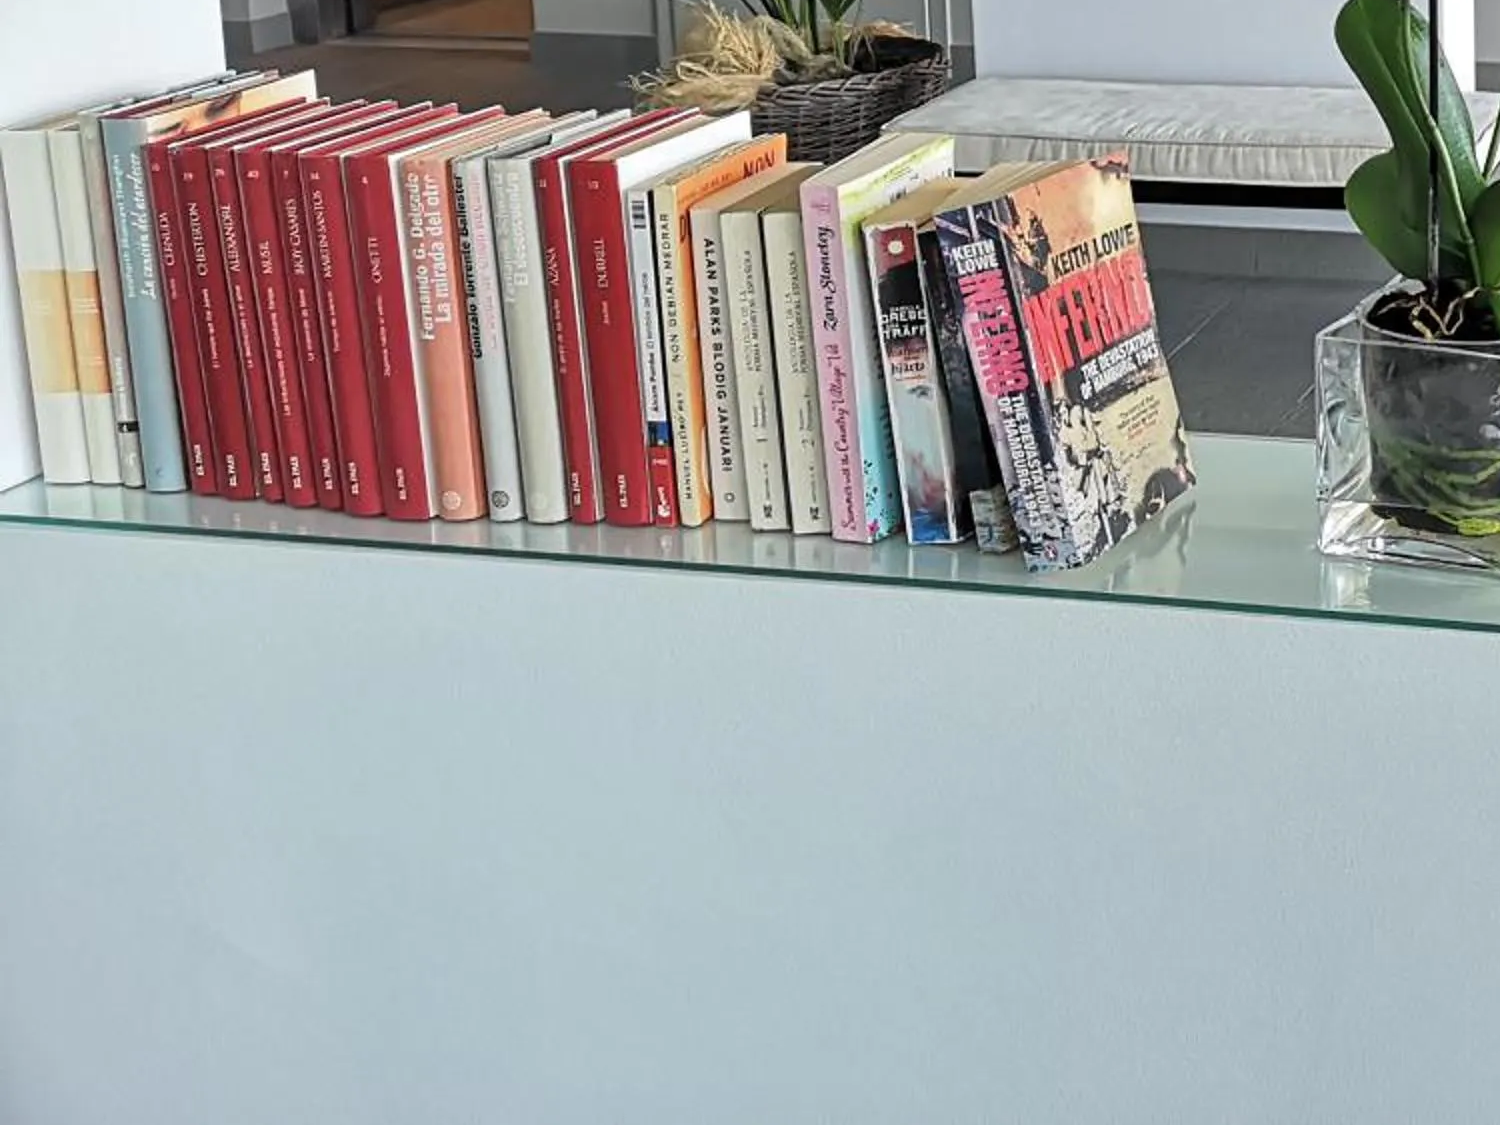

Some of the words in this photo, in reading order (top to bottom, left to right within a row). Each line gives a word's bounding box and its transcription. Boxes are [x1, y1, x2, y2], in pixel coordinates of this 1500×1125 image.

[131, 211, 152, 231] del
[406, 173, 424, 237] Delgado
[425, 211, 443, 235] del
[453, 174, 468, 237] Ballester
[188, 202, 209, 276] CHESTERTON
[411, 243, 426, 259] G.
[659, 213, 673, 269] MEDRAR
[702, 238, 717, 280] ALAN
[951, 239, 996, 261] KEITH
[956, 255, 999, 275] LOWE
[1051, 245, 1091, 275] KEITH
[1094, 223, 1136, 258] LOWE
[428, 241, 450, 297] mirada
[459, 241, 475, 298] Torrente
[415, 266, 434, 340] Fernando
[436, 302, 452, 323] La
[664, 276, 678, 327] DEBIAN
[706, 285, 722, 335] PARKS
[822, 296, 838, 331] Zara
[1023, 251, 1153, 385] INFERNO
[467, 304, 482, 358] Gonzalo
[670, 335, 681, 363] NON
[959, 268, 1030, 398] INFERNO
[1079, 360, 1099, 381] THE
[1097, 329, 1155, 369] DEVASTATION
[710, 342, 727, 399] BLODIG
[829, 364, 847, 407] Village
[1079, 379, 1093, 400] OF
[1135, 346, 1159, 368] 1943
[833, 408, 851, 453] Country
[1010, 392, 1025, 420] THE
[715, 405, 733, 472] JANUARI
[998, 398, 1011, 415] OF
[1022, 490, 1041, 526] 1943
[1017, 421, 1051, 514] DEVASTATION
[840, 485, 857, 531] Summer
